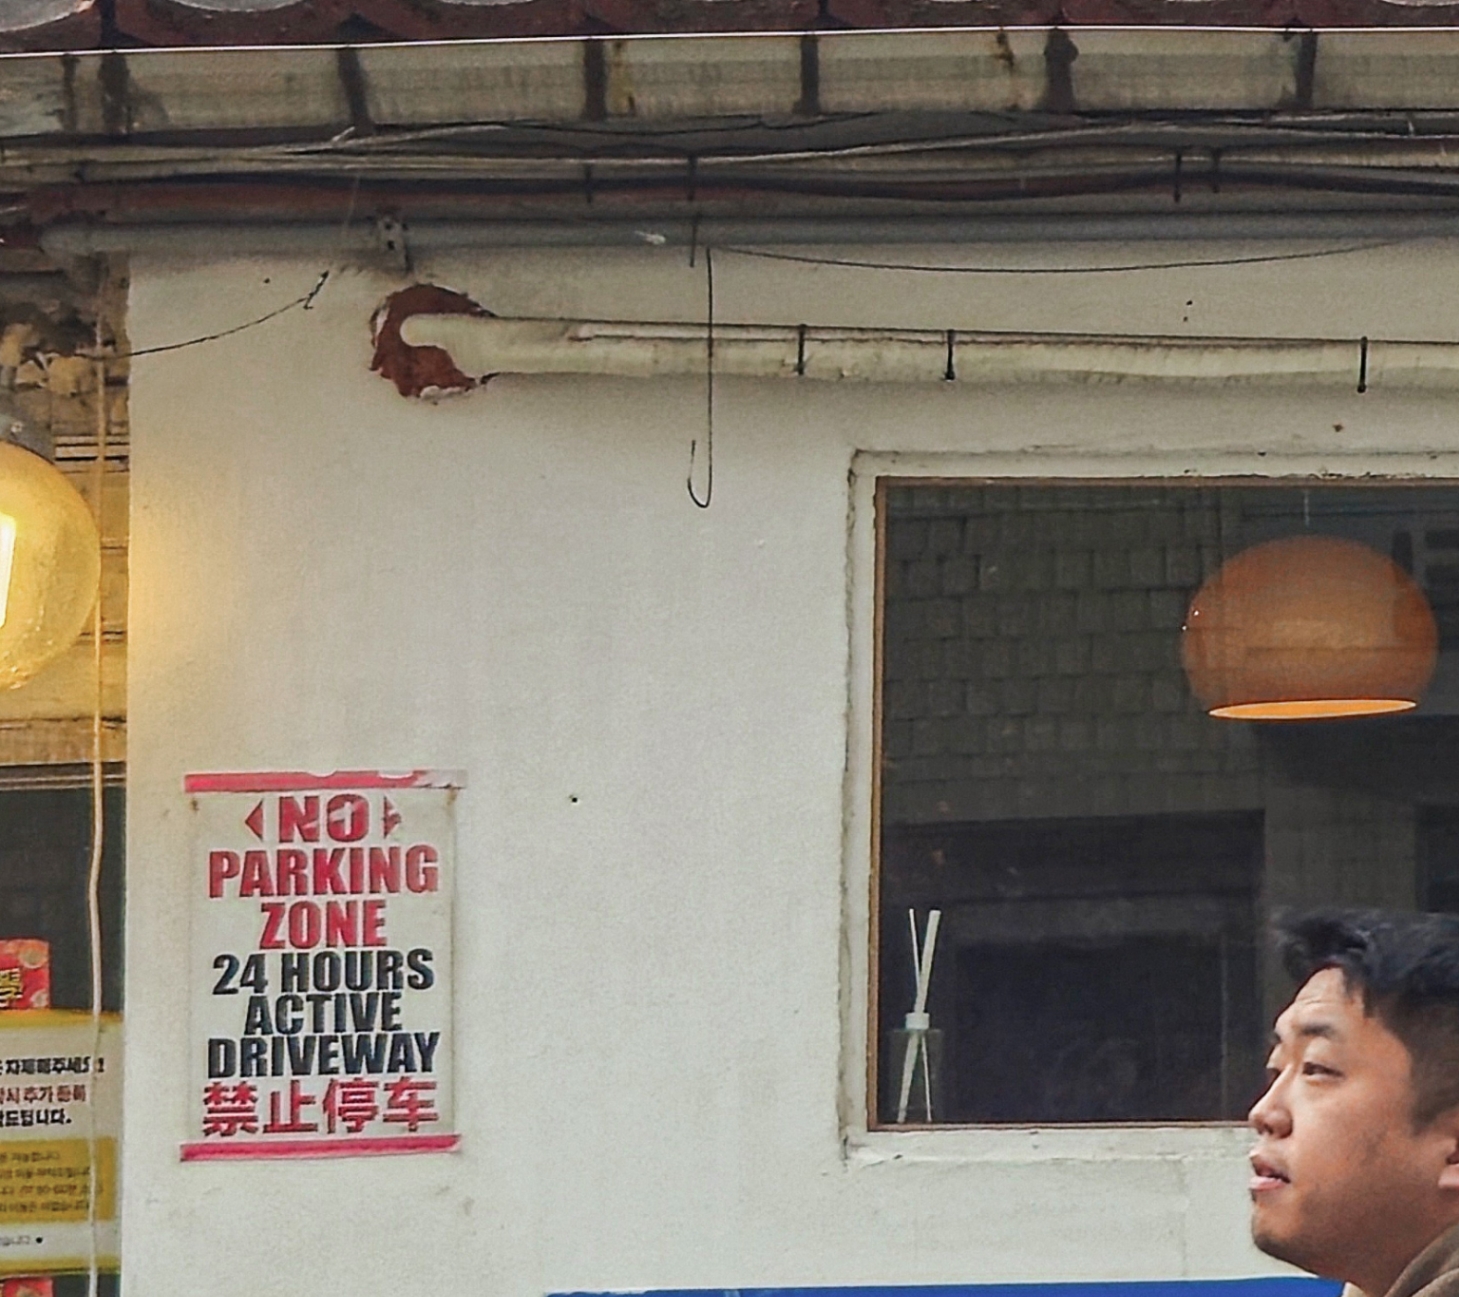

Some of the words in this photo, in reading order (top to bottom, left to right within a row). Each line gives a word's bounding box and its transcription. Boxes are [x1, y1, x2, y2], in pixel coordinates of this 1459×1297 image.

[279, 794, 370, 842] NO
[209, 845, 439, 898] PARKING
[259, 899, 387, 950] ZONE
[212, 953, 269, 995] 24
[281, 949, 435, 993] HOURS
[243, 992, 403, 1036] ACTIVE
[207, 1032, 440, 1079] DRIVEWAY
[0, 1108, 72, 1128] 드립니다.
[203, 1076, 440, 1137] 禁止停车
